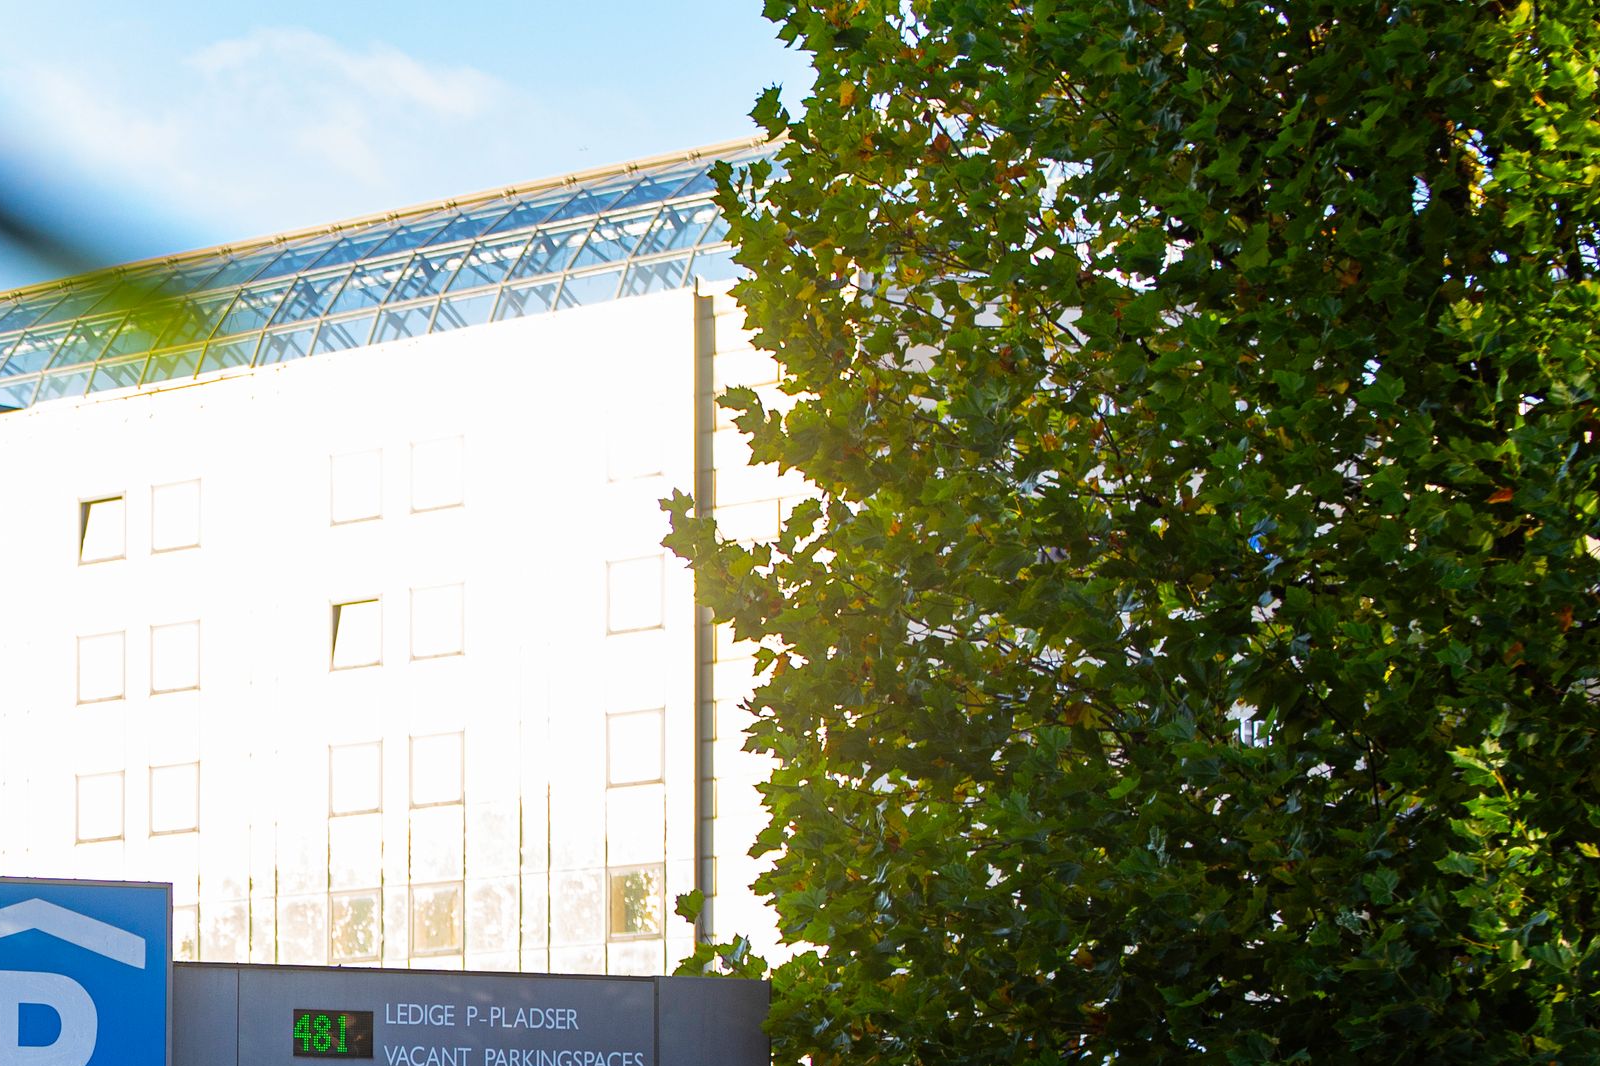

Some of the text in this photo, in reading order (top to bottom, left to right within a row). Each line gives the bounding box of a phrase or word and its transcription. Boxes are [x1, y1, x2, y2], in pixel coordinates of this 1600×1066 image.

[385, 1002, 579, 1030] LEDIGE P-PLADSER
[293, 1014, 348, 1054] 481
